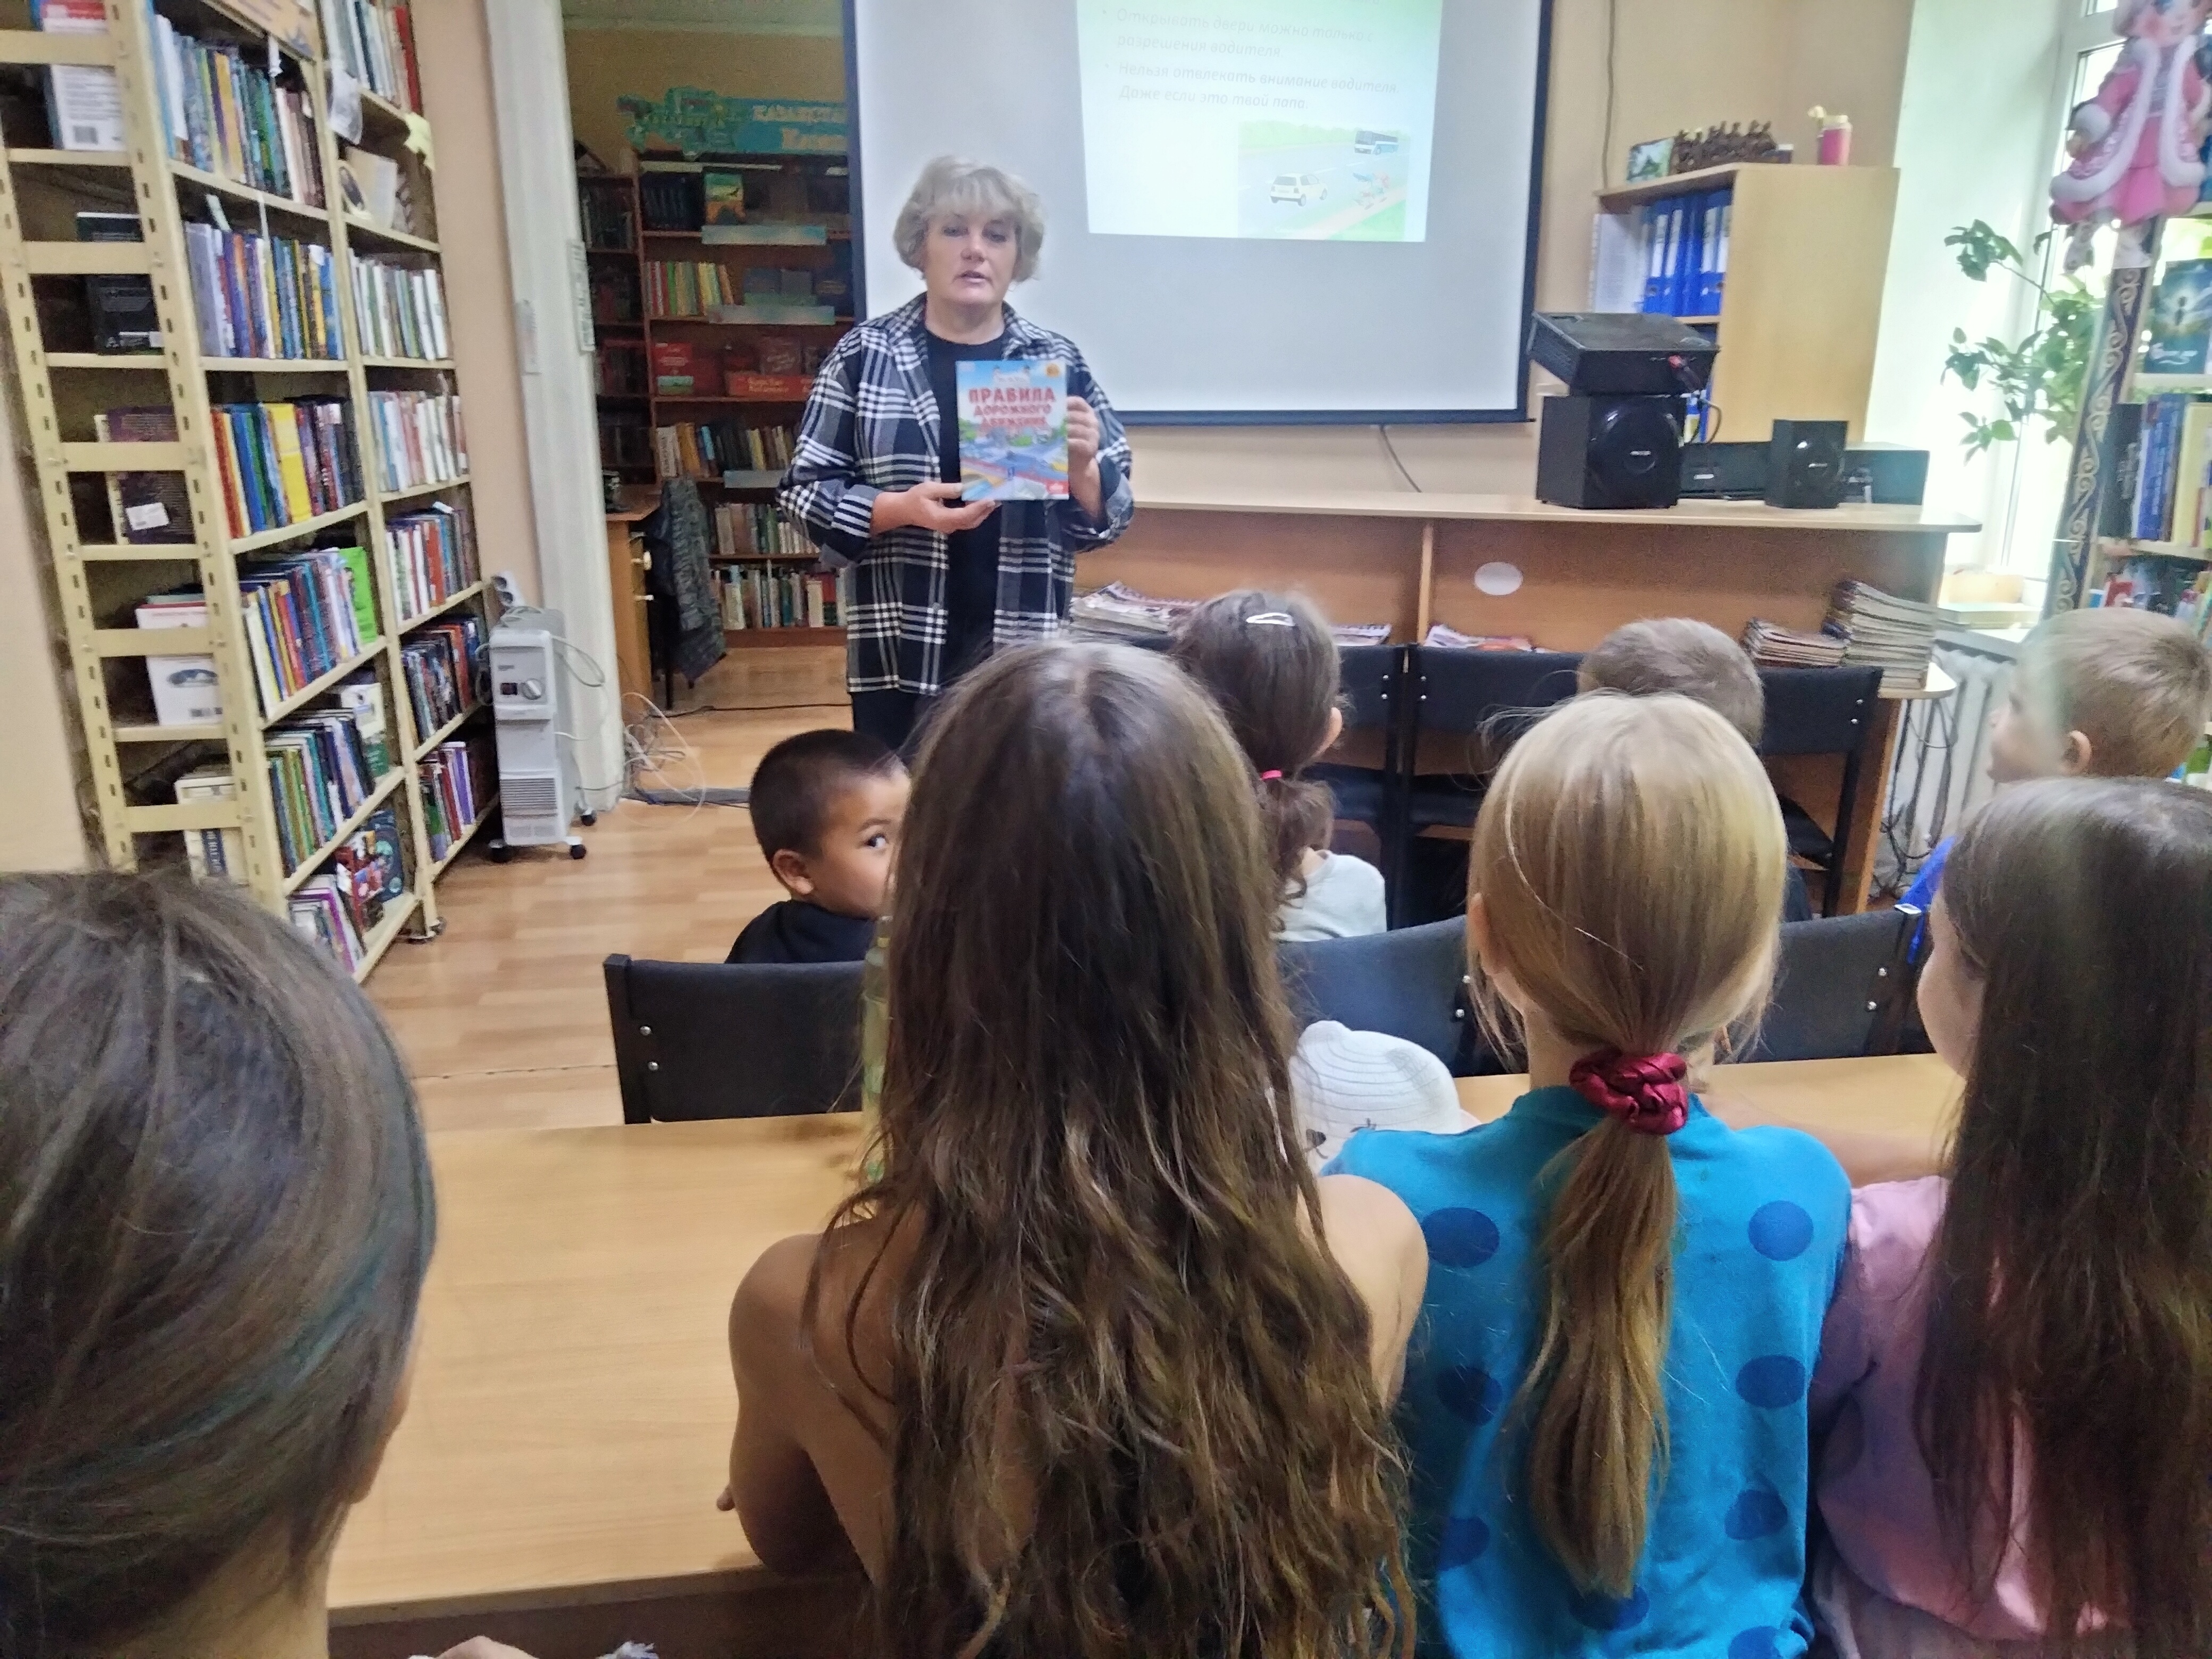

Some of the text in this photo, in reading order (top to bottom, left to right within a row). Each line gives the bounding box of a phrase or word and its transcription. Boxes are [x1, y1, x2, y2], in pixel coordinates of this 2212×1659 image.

[1117, 9, 1209, 29] Открывать
[1213, 15, 1255, 33] двери
[1259, 23, 1309, 37] можно
[1312, 27, 1364, 42] только
[1117, 35, 1206, 52] разрешения
[1119, 62, 1400, 94] Нельзя отвлекать внимание водителя.
[1119, 85, 1309, 110] Даже если это твой папа.
[968, 388, 1055, 403] ПРАВИЛА
